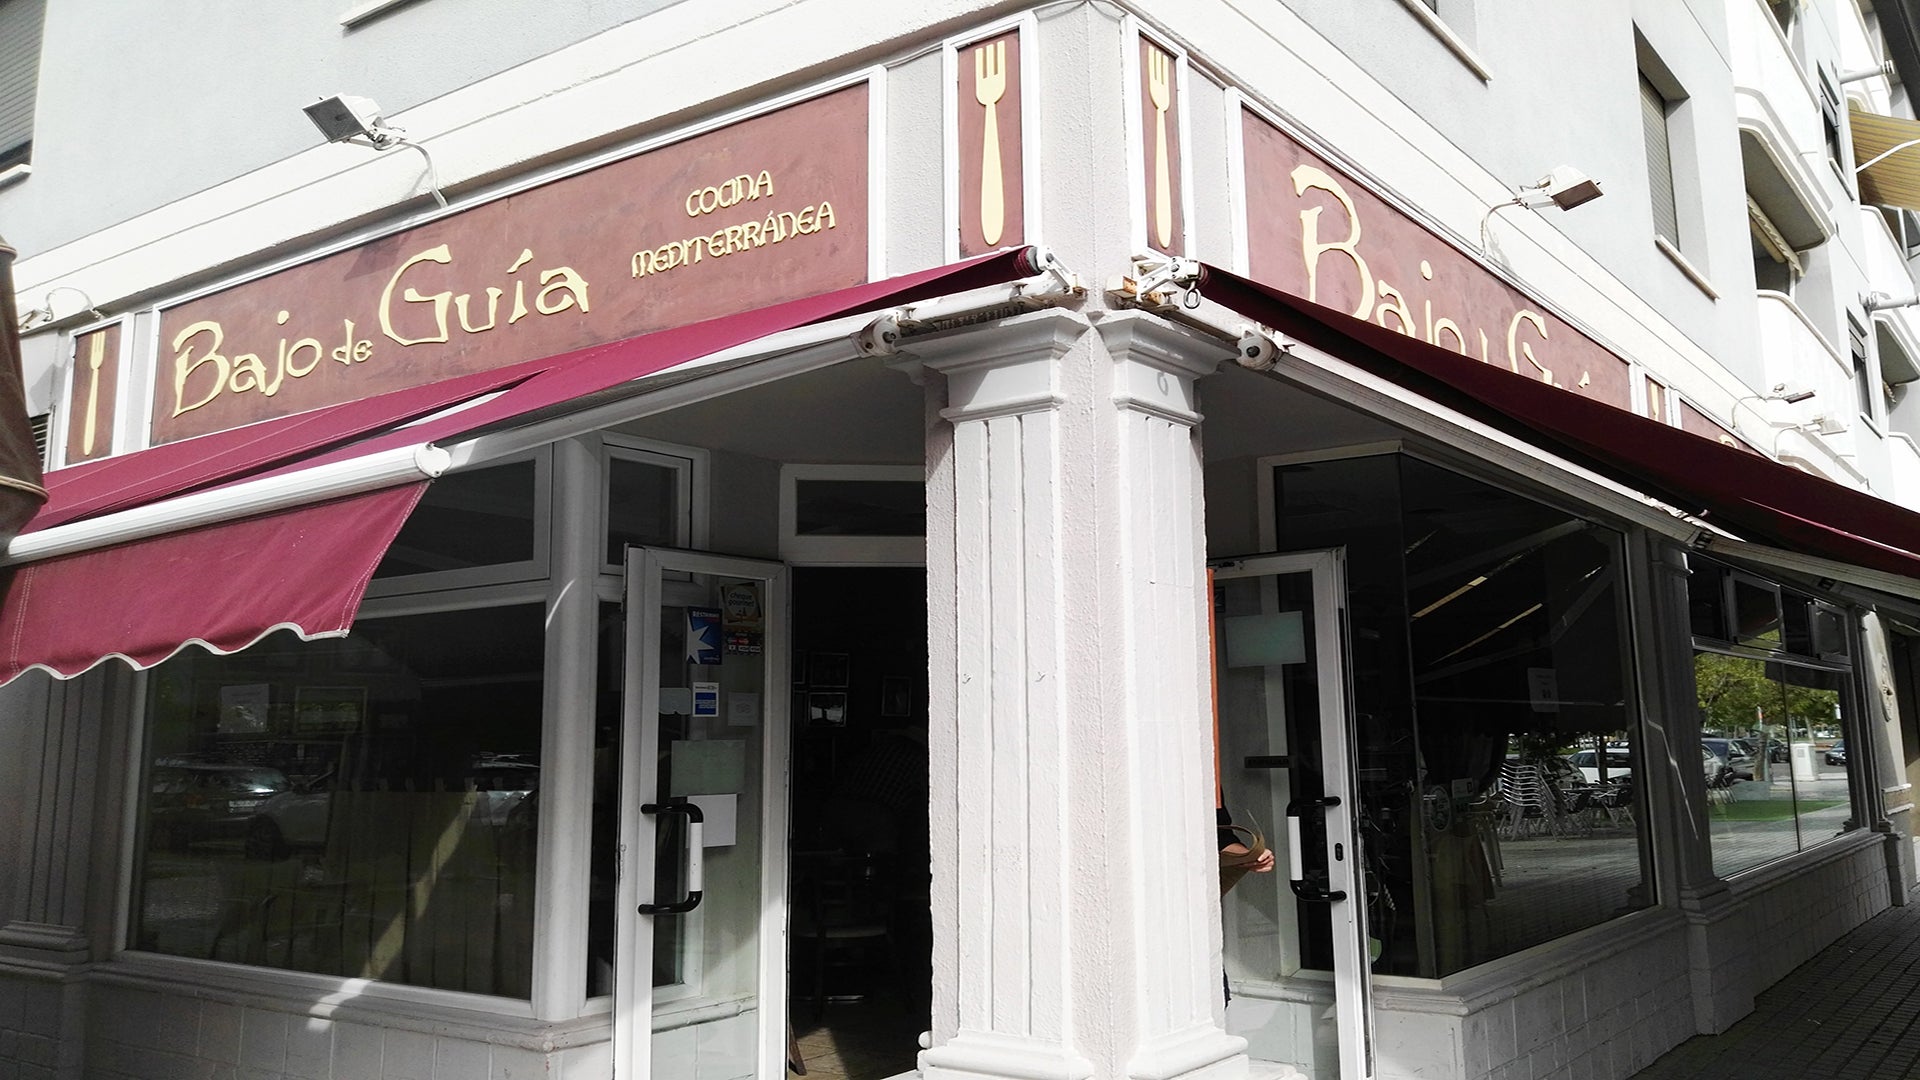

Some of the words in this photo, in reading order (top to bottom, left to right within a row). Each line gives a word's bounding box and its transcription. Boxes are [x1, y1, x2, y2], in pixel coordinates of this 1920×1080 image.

[686, 170, 774, 216] COCINA
[631, 201, 837, 277] MEDITERRÁNEA
[172, 310, 323, 418] Bajo
[331, 319, 373, 364] de
[378, 244, 590, 345] Guía
